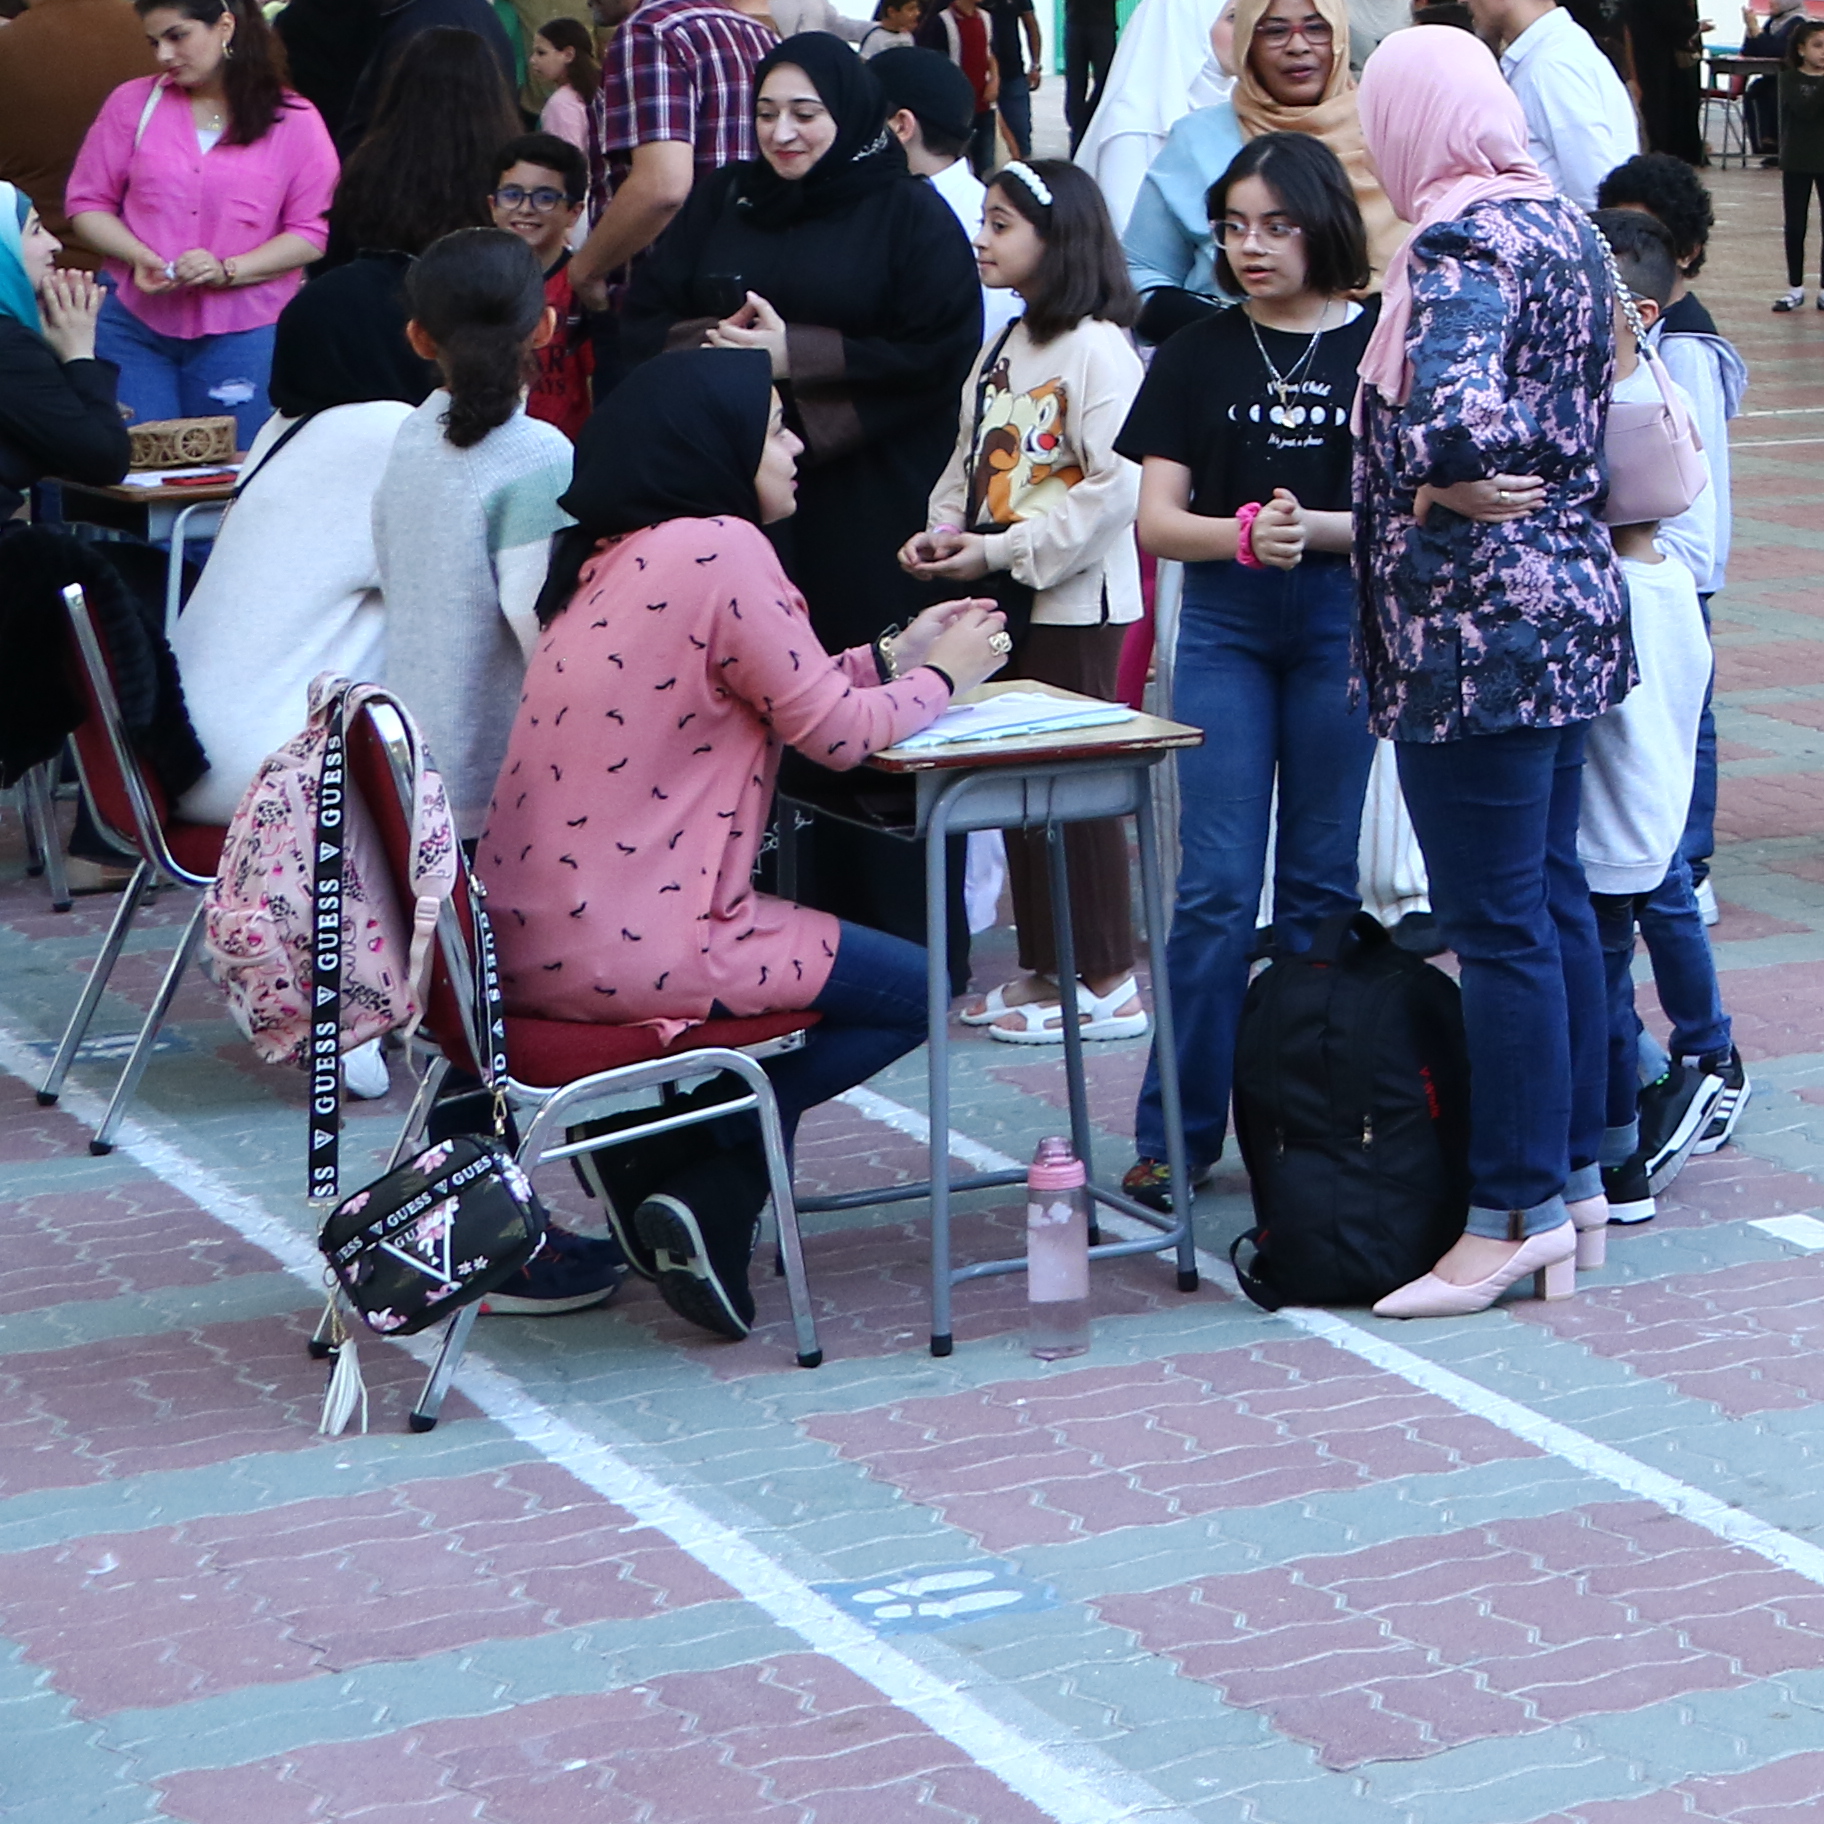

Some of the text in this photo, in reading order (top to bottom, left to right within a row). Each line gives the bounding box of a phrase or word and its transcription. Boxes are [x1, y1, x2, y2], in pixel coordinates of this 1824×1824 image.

[321, 734, 343, 828] GUESS
[318, 877, 341, 971] GUESS
[315, 1021, 338, 1116] GUESS
[336, 1235, 363, 1264] ESS
[387, 1191, 432, 1227] GUESS
[452, 1155, 493, 1186] GUES
